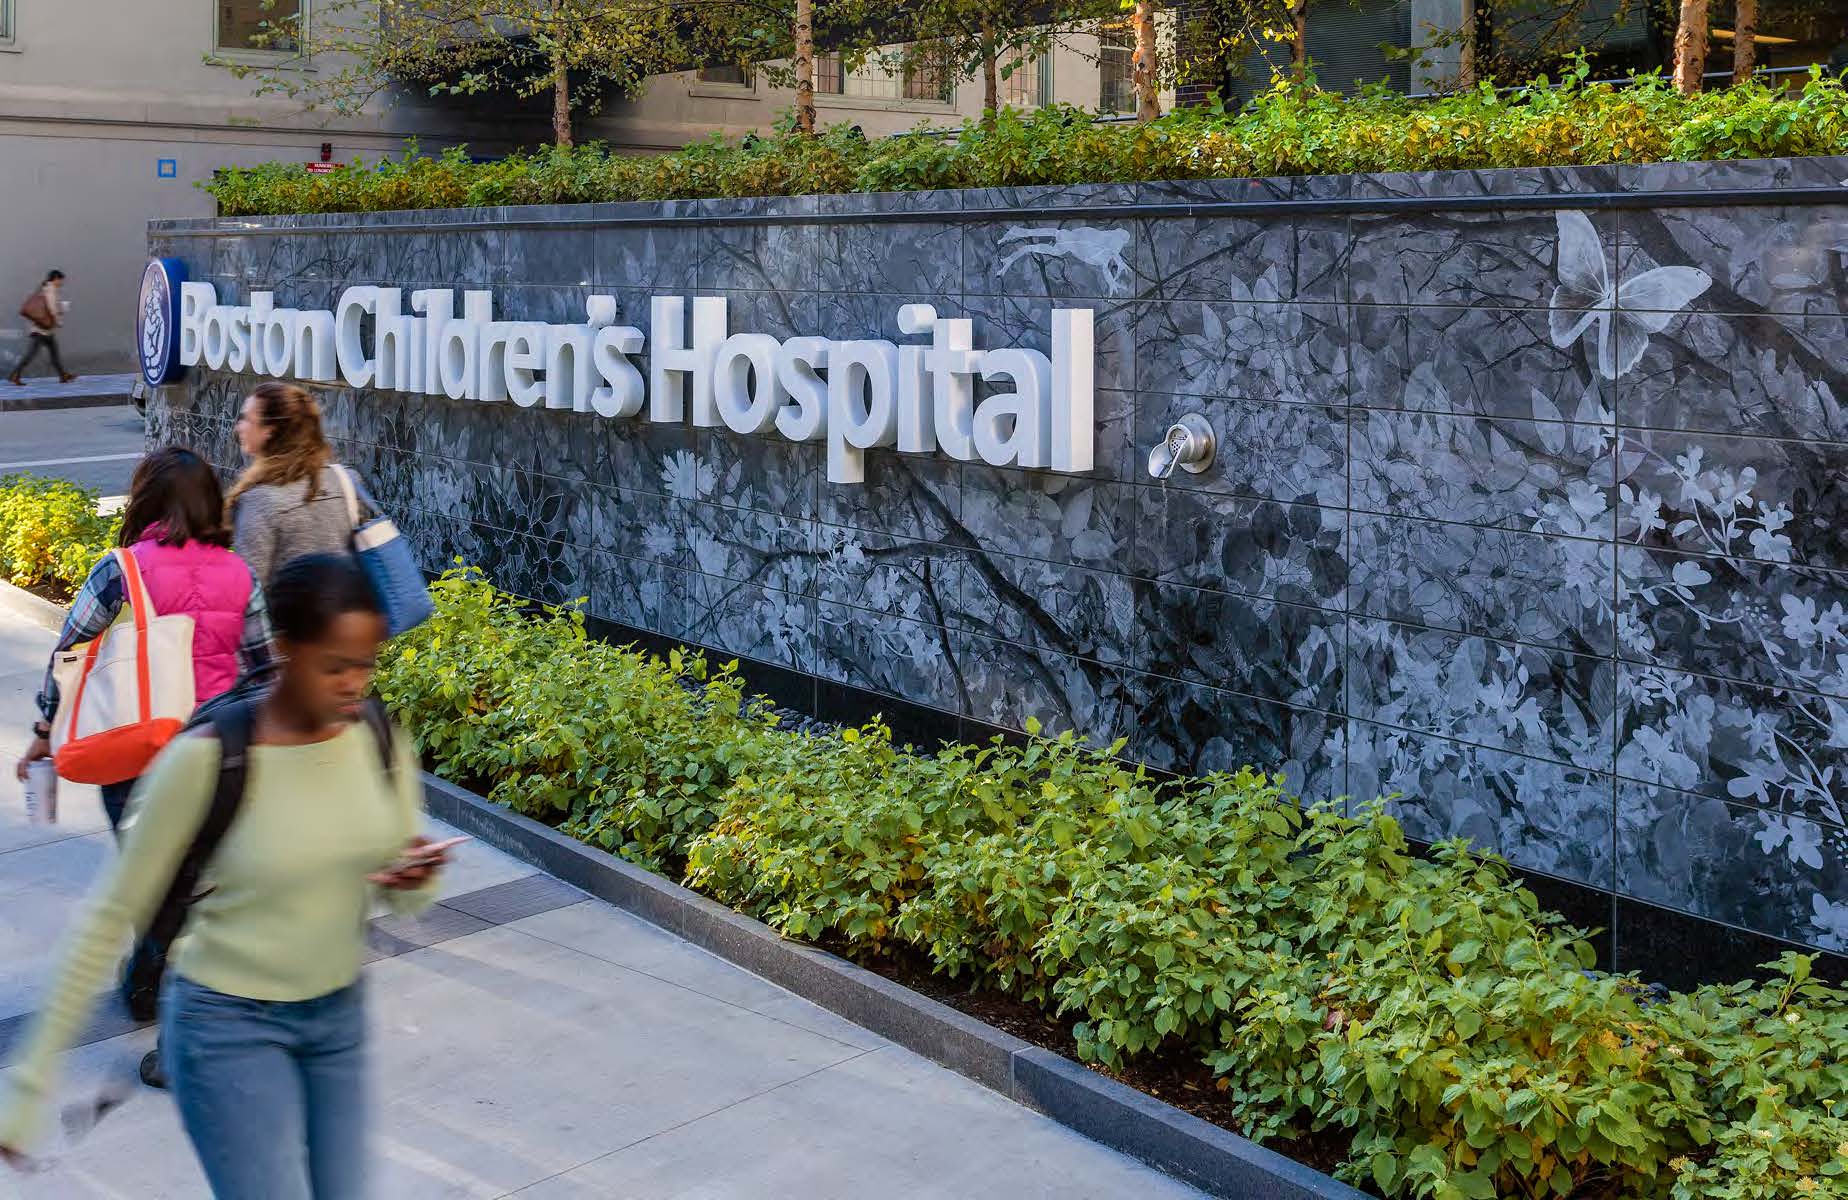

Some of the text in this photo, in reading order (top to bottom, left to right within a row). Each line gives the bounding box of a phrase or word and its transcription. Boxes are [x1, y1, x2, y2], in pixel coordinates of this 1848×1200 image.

[180, 281, 1094, 484] Boston Children's Hospital
